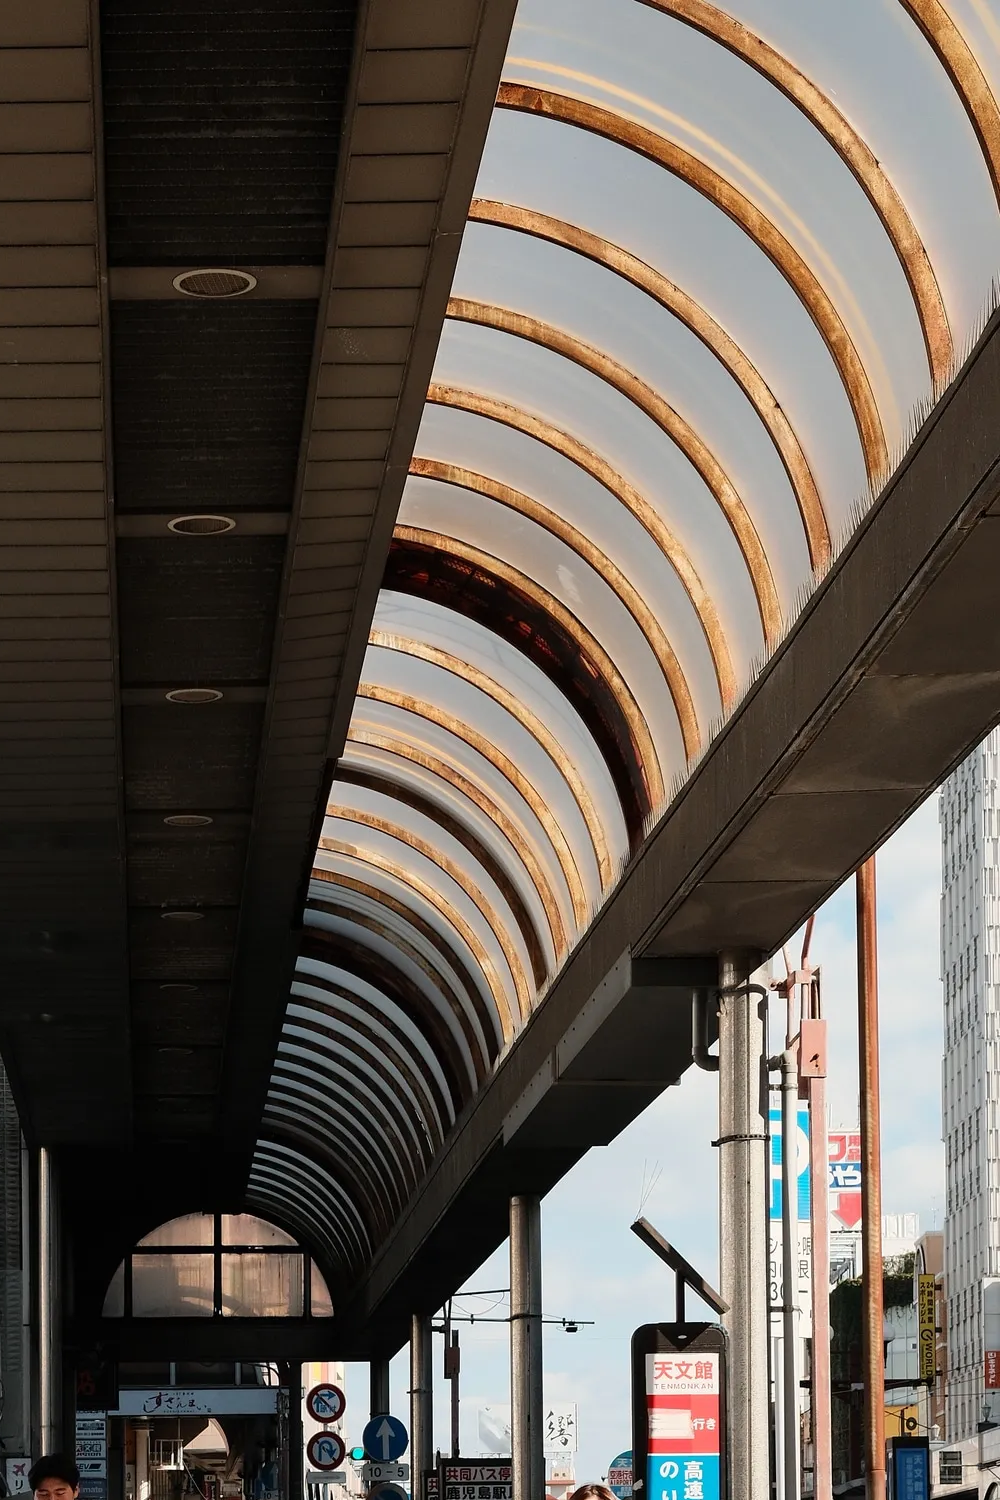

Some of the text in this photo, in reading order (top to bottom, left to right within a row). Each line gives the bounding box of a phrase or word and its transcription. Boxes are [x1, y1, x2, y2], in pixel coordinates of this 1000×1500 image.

[925, 1342, 933, 1376] WORLD
[653, 1361, 713, 1380] 天文館
[692, 1418, 716, 1430] 行き
[446, 1467, 512, 1481] 共同バス停
